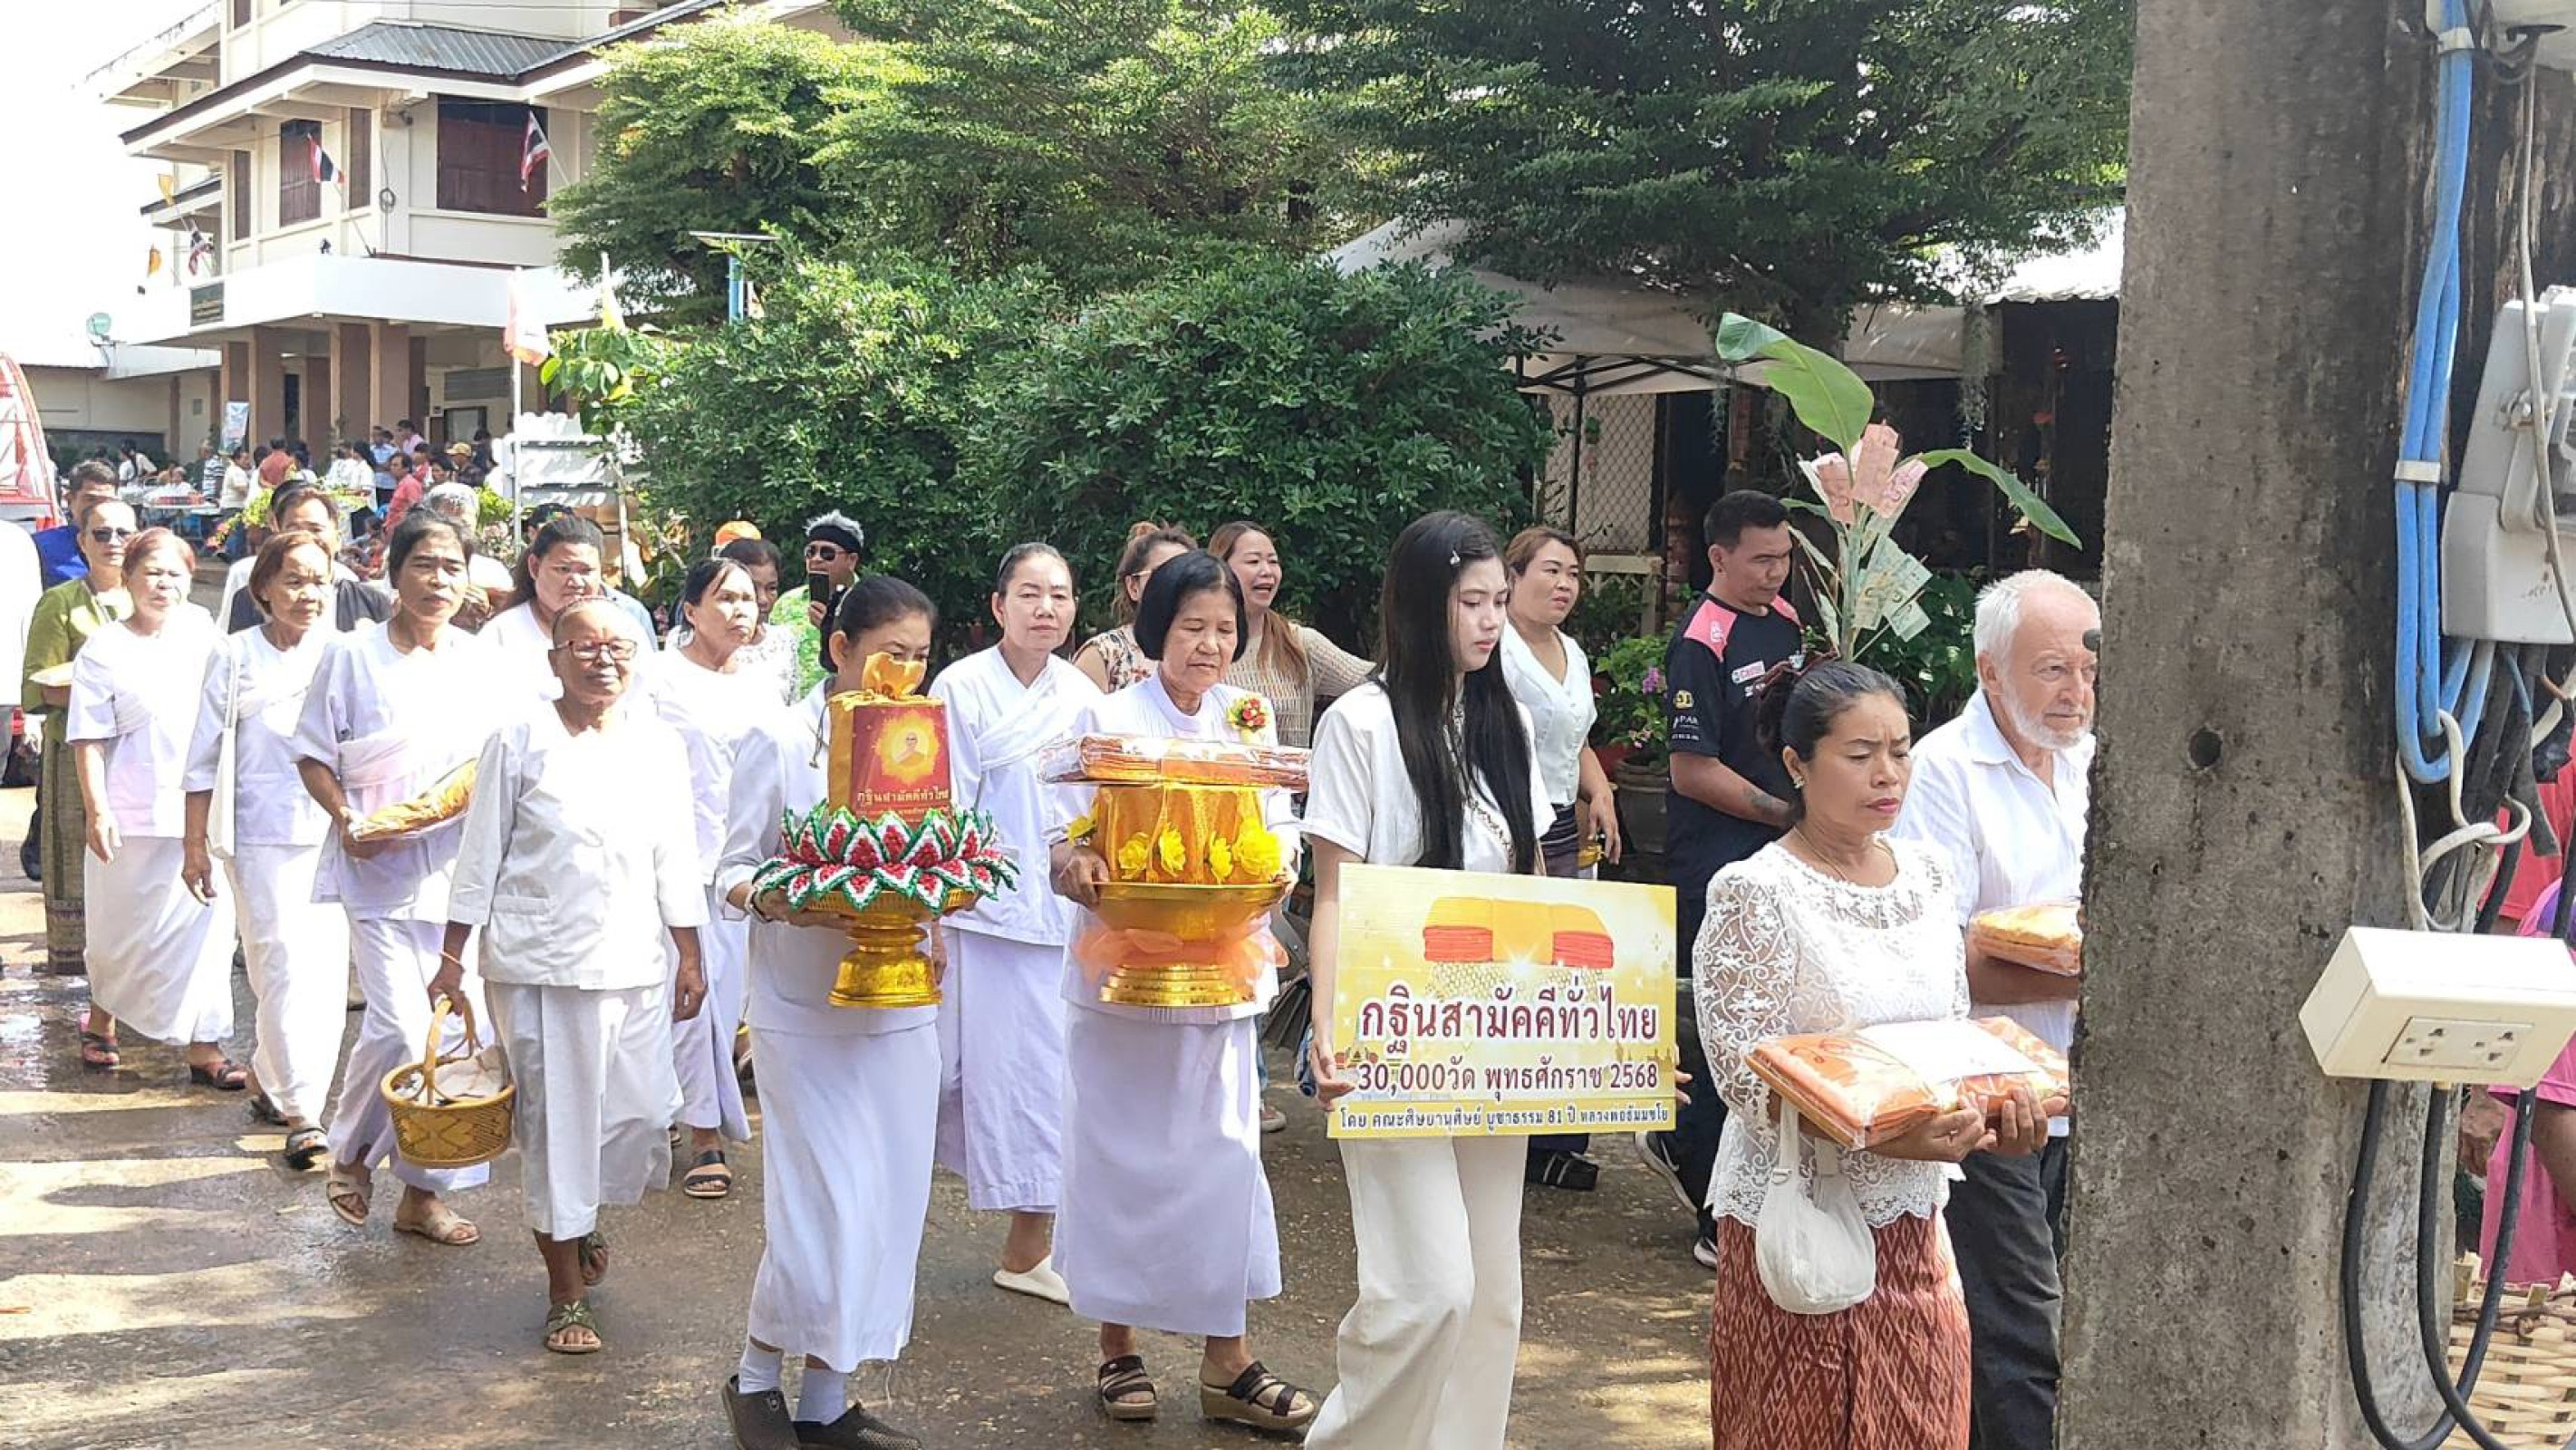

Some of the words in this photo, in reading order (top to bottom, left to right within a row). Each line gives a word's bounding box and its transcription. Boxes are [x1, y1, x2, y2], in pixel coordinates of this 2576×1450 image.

[1362, 976, 1656, 1054] กฐินสามัคคีทั่วไทย
[1358, 1056, 1475, 1097] 30,000วัด
[1485, 1056, 1603, 1101] พุทธศักราช
[1610, 1063, 1658, 1088] 2568
[1340, 1107, 1367, 1127] โดย
[1372, 1106, 1482, 1131] คณะศิษยานุศิษย์
[1487, 1111, 1543, 1131] บูชาธรรม
[1548, 1109, 1562, 1125] 81
[1568, 1105, 1576, 1124] ปี
